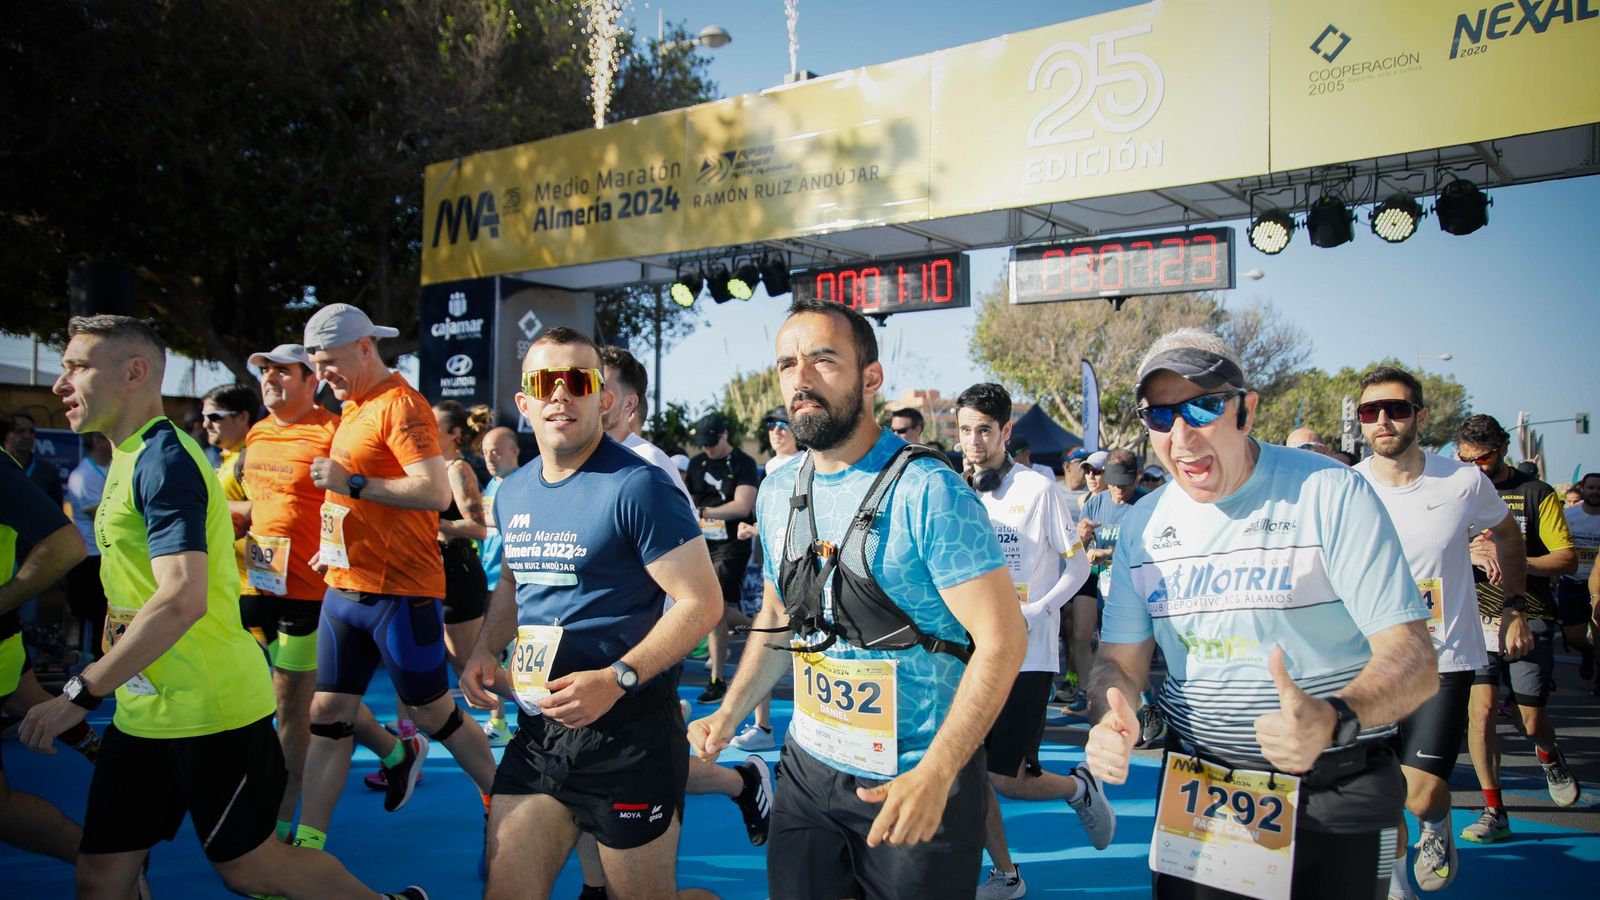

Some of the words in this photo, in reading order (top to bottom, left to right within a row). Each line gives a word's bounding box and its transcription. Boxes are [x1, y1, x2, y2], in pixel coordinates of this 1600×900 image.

[1309, 51, 1420, 82] COOPERACIÓN
[1459, 44, 1488, 58] 2020
[1027, 23, 1165, 148] 25
[1309, 80, 1345, 96] 2005
[1024, 137, 1165, 184] EDICIÓN
[534, 177, 590, 202] Medio
[596, 160, 681, 191] Maratón
[693, 186, 748, 209] RAMÓN
[754, 180, 793, 199] RUIZ
[799, 165, 880, 192] ANDÚJAR
[533, 199, 612, 232] Almería
[617, 185, 680, 219] 2024
[431, 317, 484, 340] cajamar
[505, 531, 532, 543] Medio
[534, 530, 578, 543] Maratón
[524, 562, 540, 570] RUIZ
[804, 665, 882, 714] 1932
[820, 703, 849, 720] DANIEL
[620, 811, 641, 819] MOYA
[1180, 779, 1283, 832] 1292
